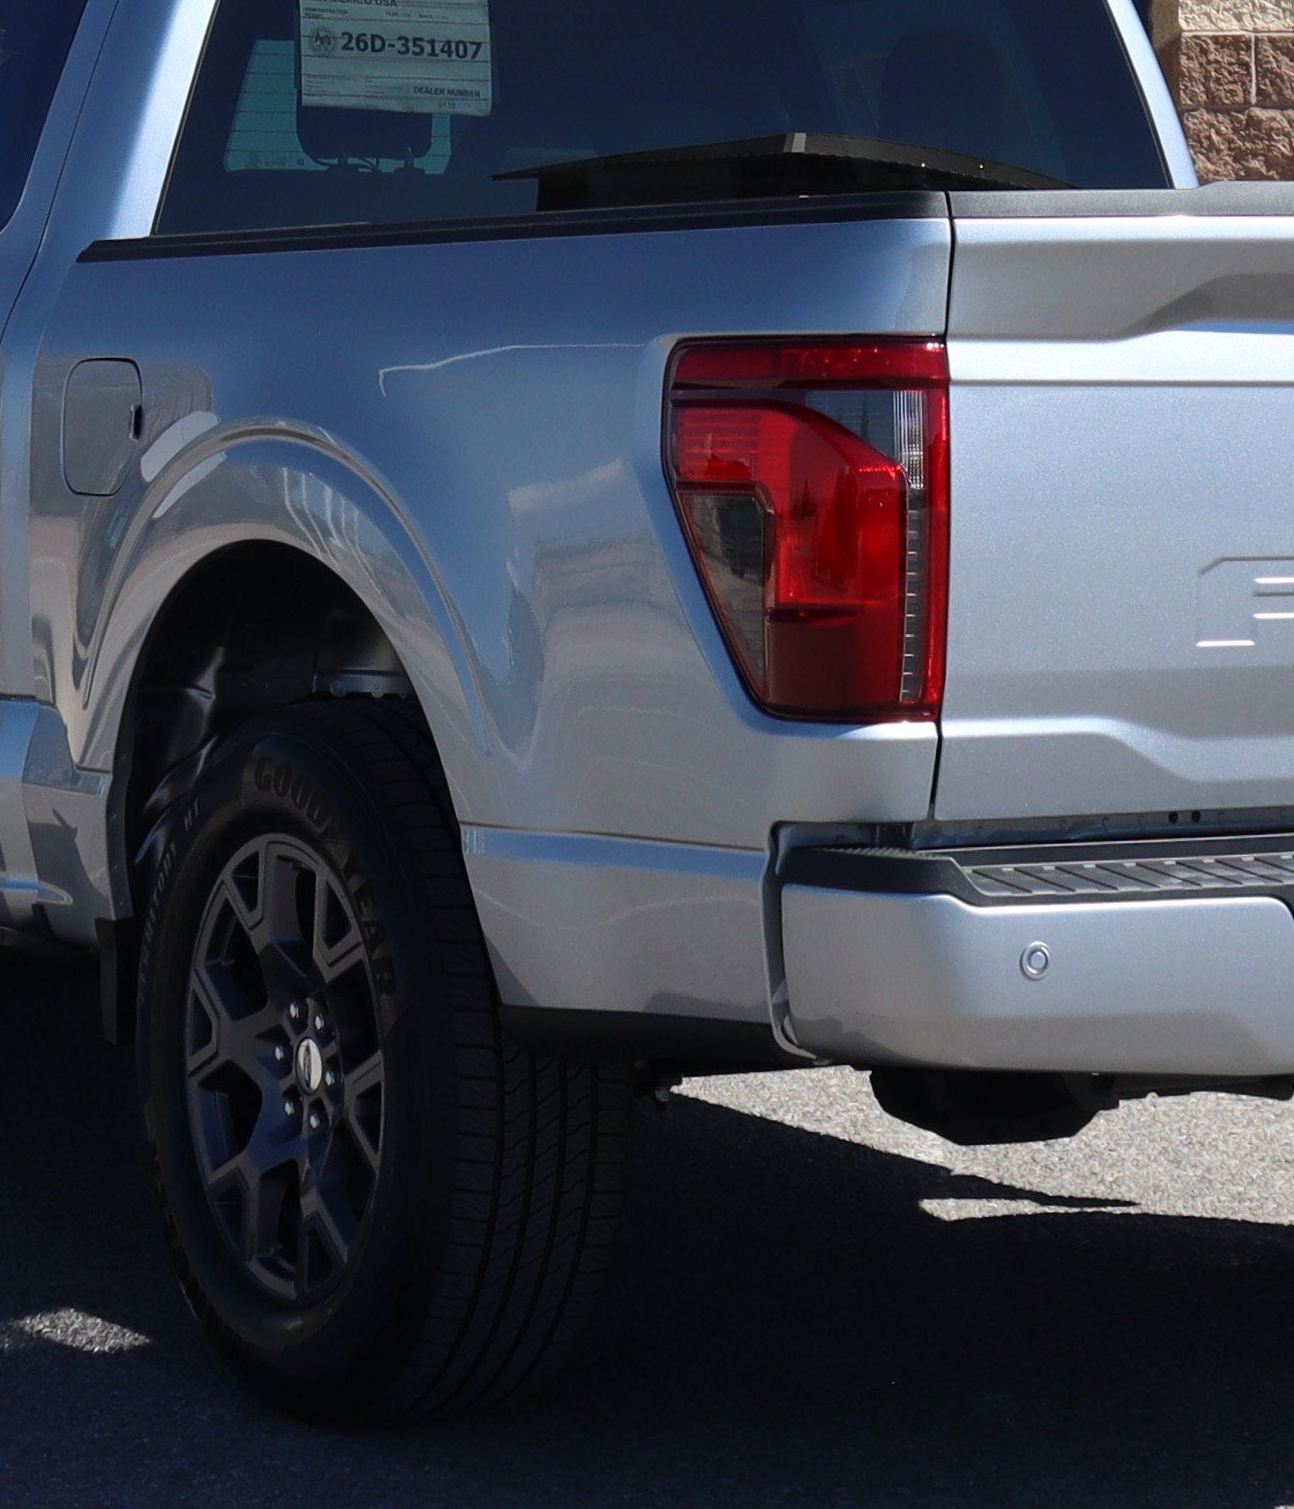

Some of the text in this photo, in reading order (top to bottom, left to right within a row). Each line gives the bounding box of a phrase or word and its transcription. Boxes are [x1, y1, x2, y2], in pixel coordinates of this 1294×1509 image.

[341, 31, 482, 60] 26D-351407
[413, 86, 446, 97] DEALER
[446, 88, 481, 98] NUMBER
